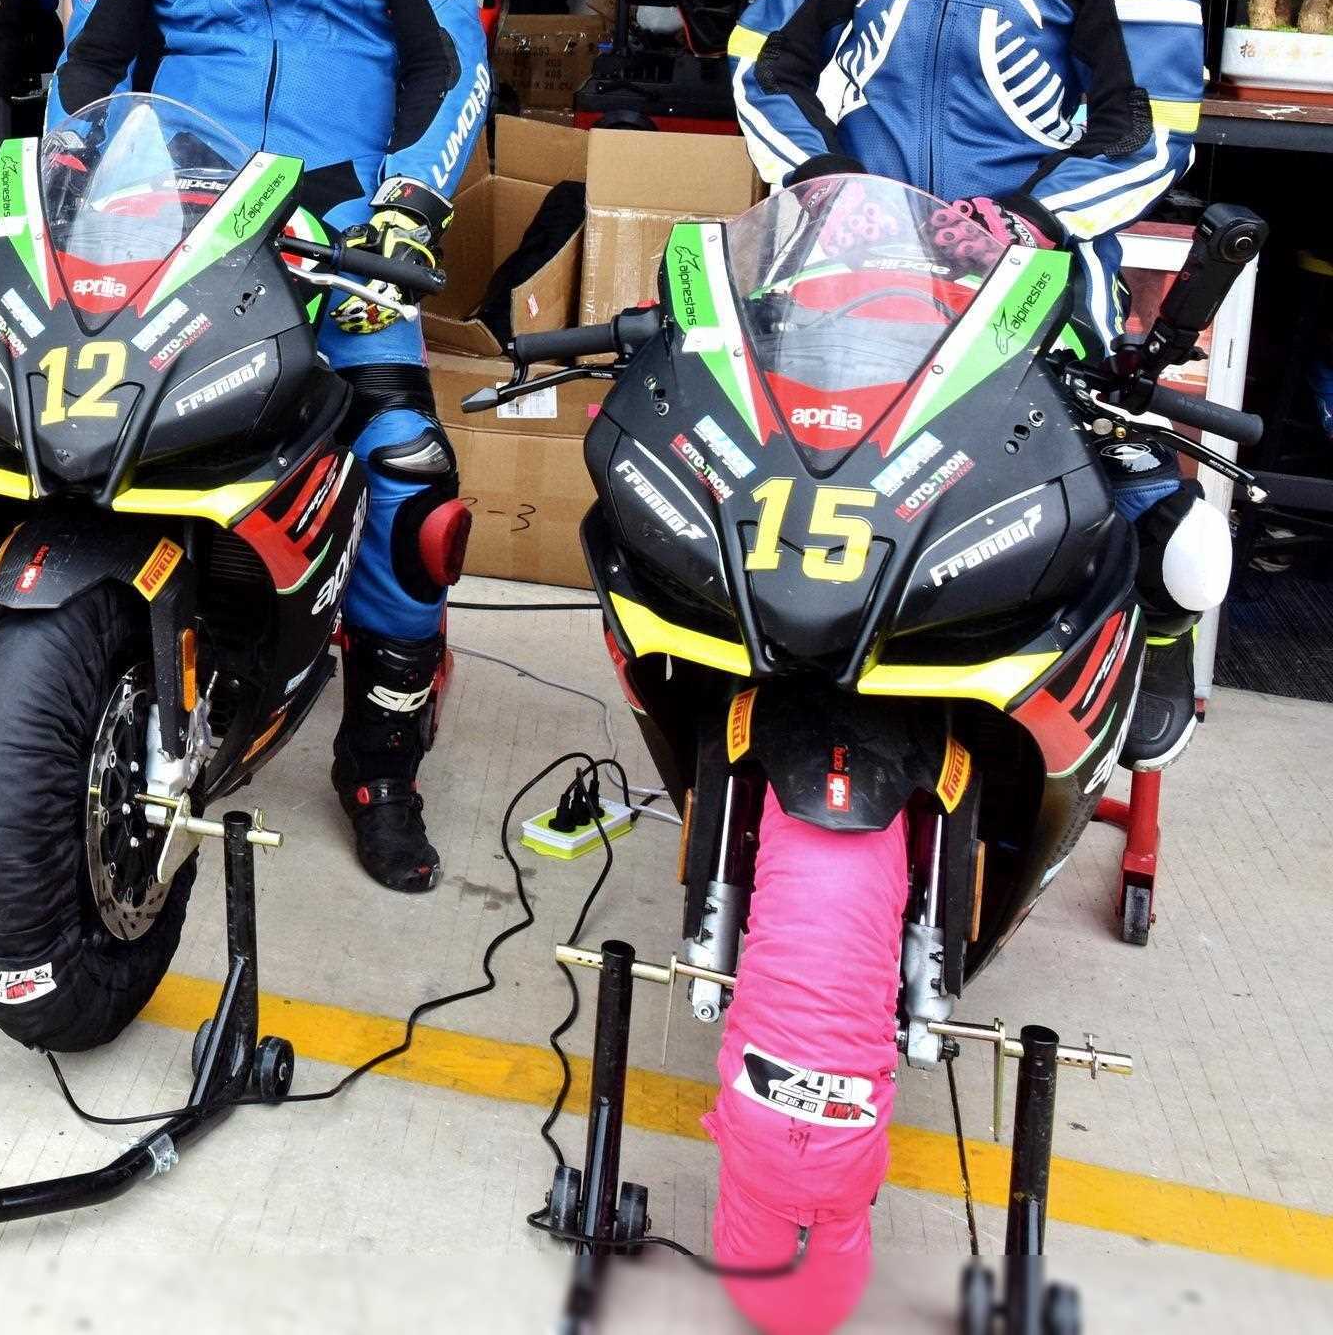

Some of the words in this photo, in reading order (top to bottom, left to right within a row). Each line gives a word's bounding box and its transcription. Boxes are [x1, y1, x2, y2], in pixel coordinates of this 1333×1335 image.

[2, 168, 13, 218] alpinestars
[247, 173, 287, 218] alpinestars
[73, 274, 128, 299] aprilia
[679, 266, 698, 326] alpinestars
[1011, 271, 1052, 331] alpinestars
[149, 312, 209, 373] MOTO-TRON
[36, 339, 128, 426] 12
[790, 404, 863, 432] aprilia
[672, 433, 735, 500] MOTO-TRON
[894, 450, 971, 522] MOTO-TRON
[938, 458, 976, 496] RACING
[745, 476, 878, 583] 15
[140, 542, 177, 592] PIRELLI
[733, 689, 752, 750] PIRELLI
[832, 744, 846, 772] racing
[943, 742, 967, 803] PIRELLI
[768, 1069, 853, 1101] 299
